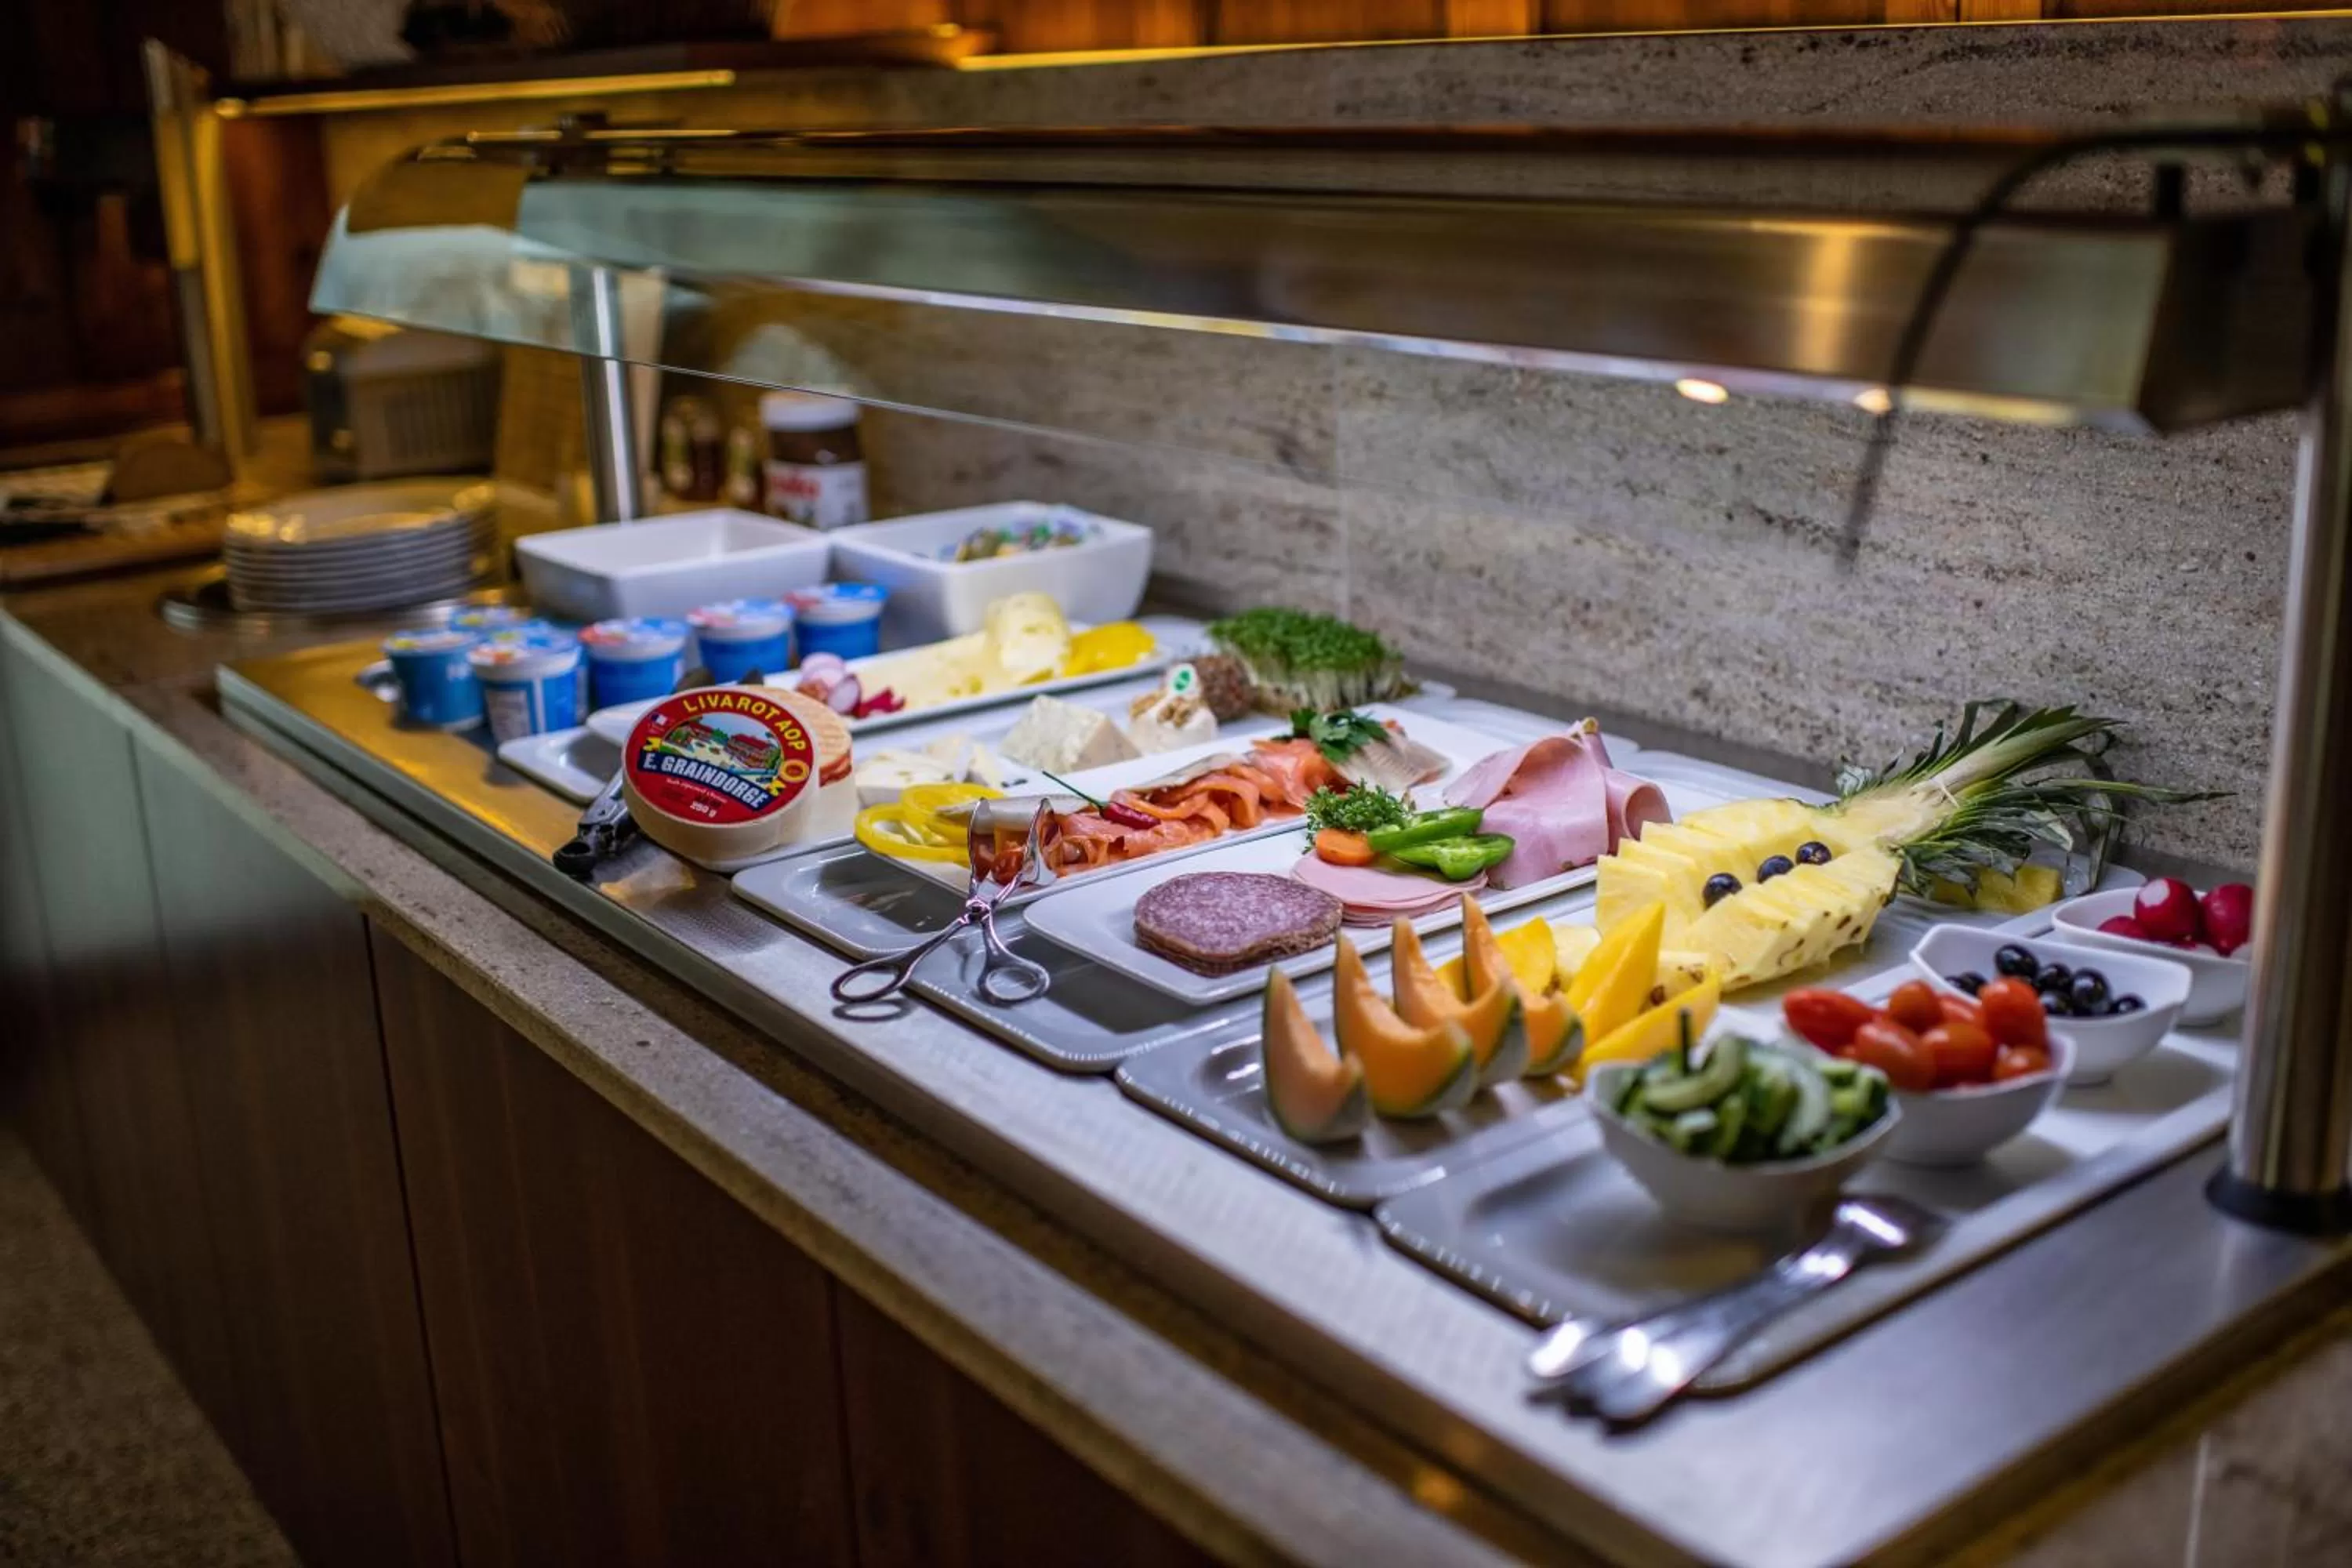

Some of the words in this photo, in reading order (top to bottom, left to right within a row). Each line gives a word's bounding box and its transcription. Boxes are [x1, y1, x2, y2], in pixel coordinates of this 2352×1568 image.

[683, 694, 780, 720] LIVAROT
[775, 719, 807, 751] AOP
[643, 752, 658, 771] E.
[661, 756, 769, 808] GRAINDORGE
